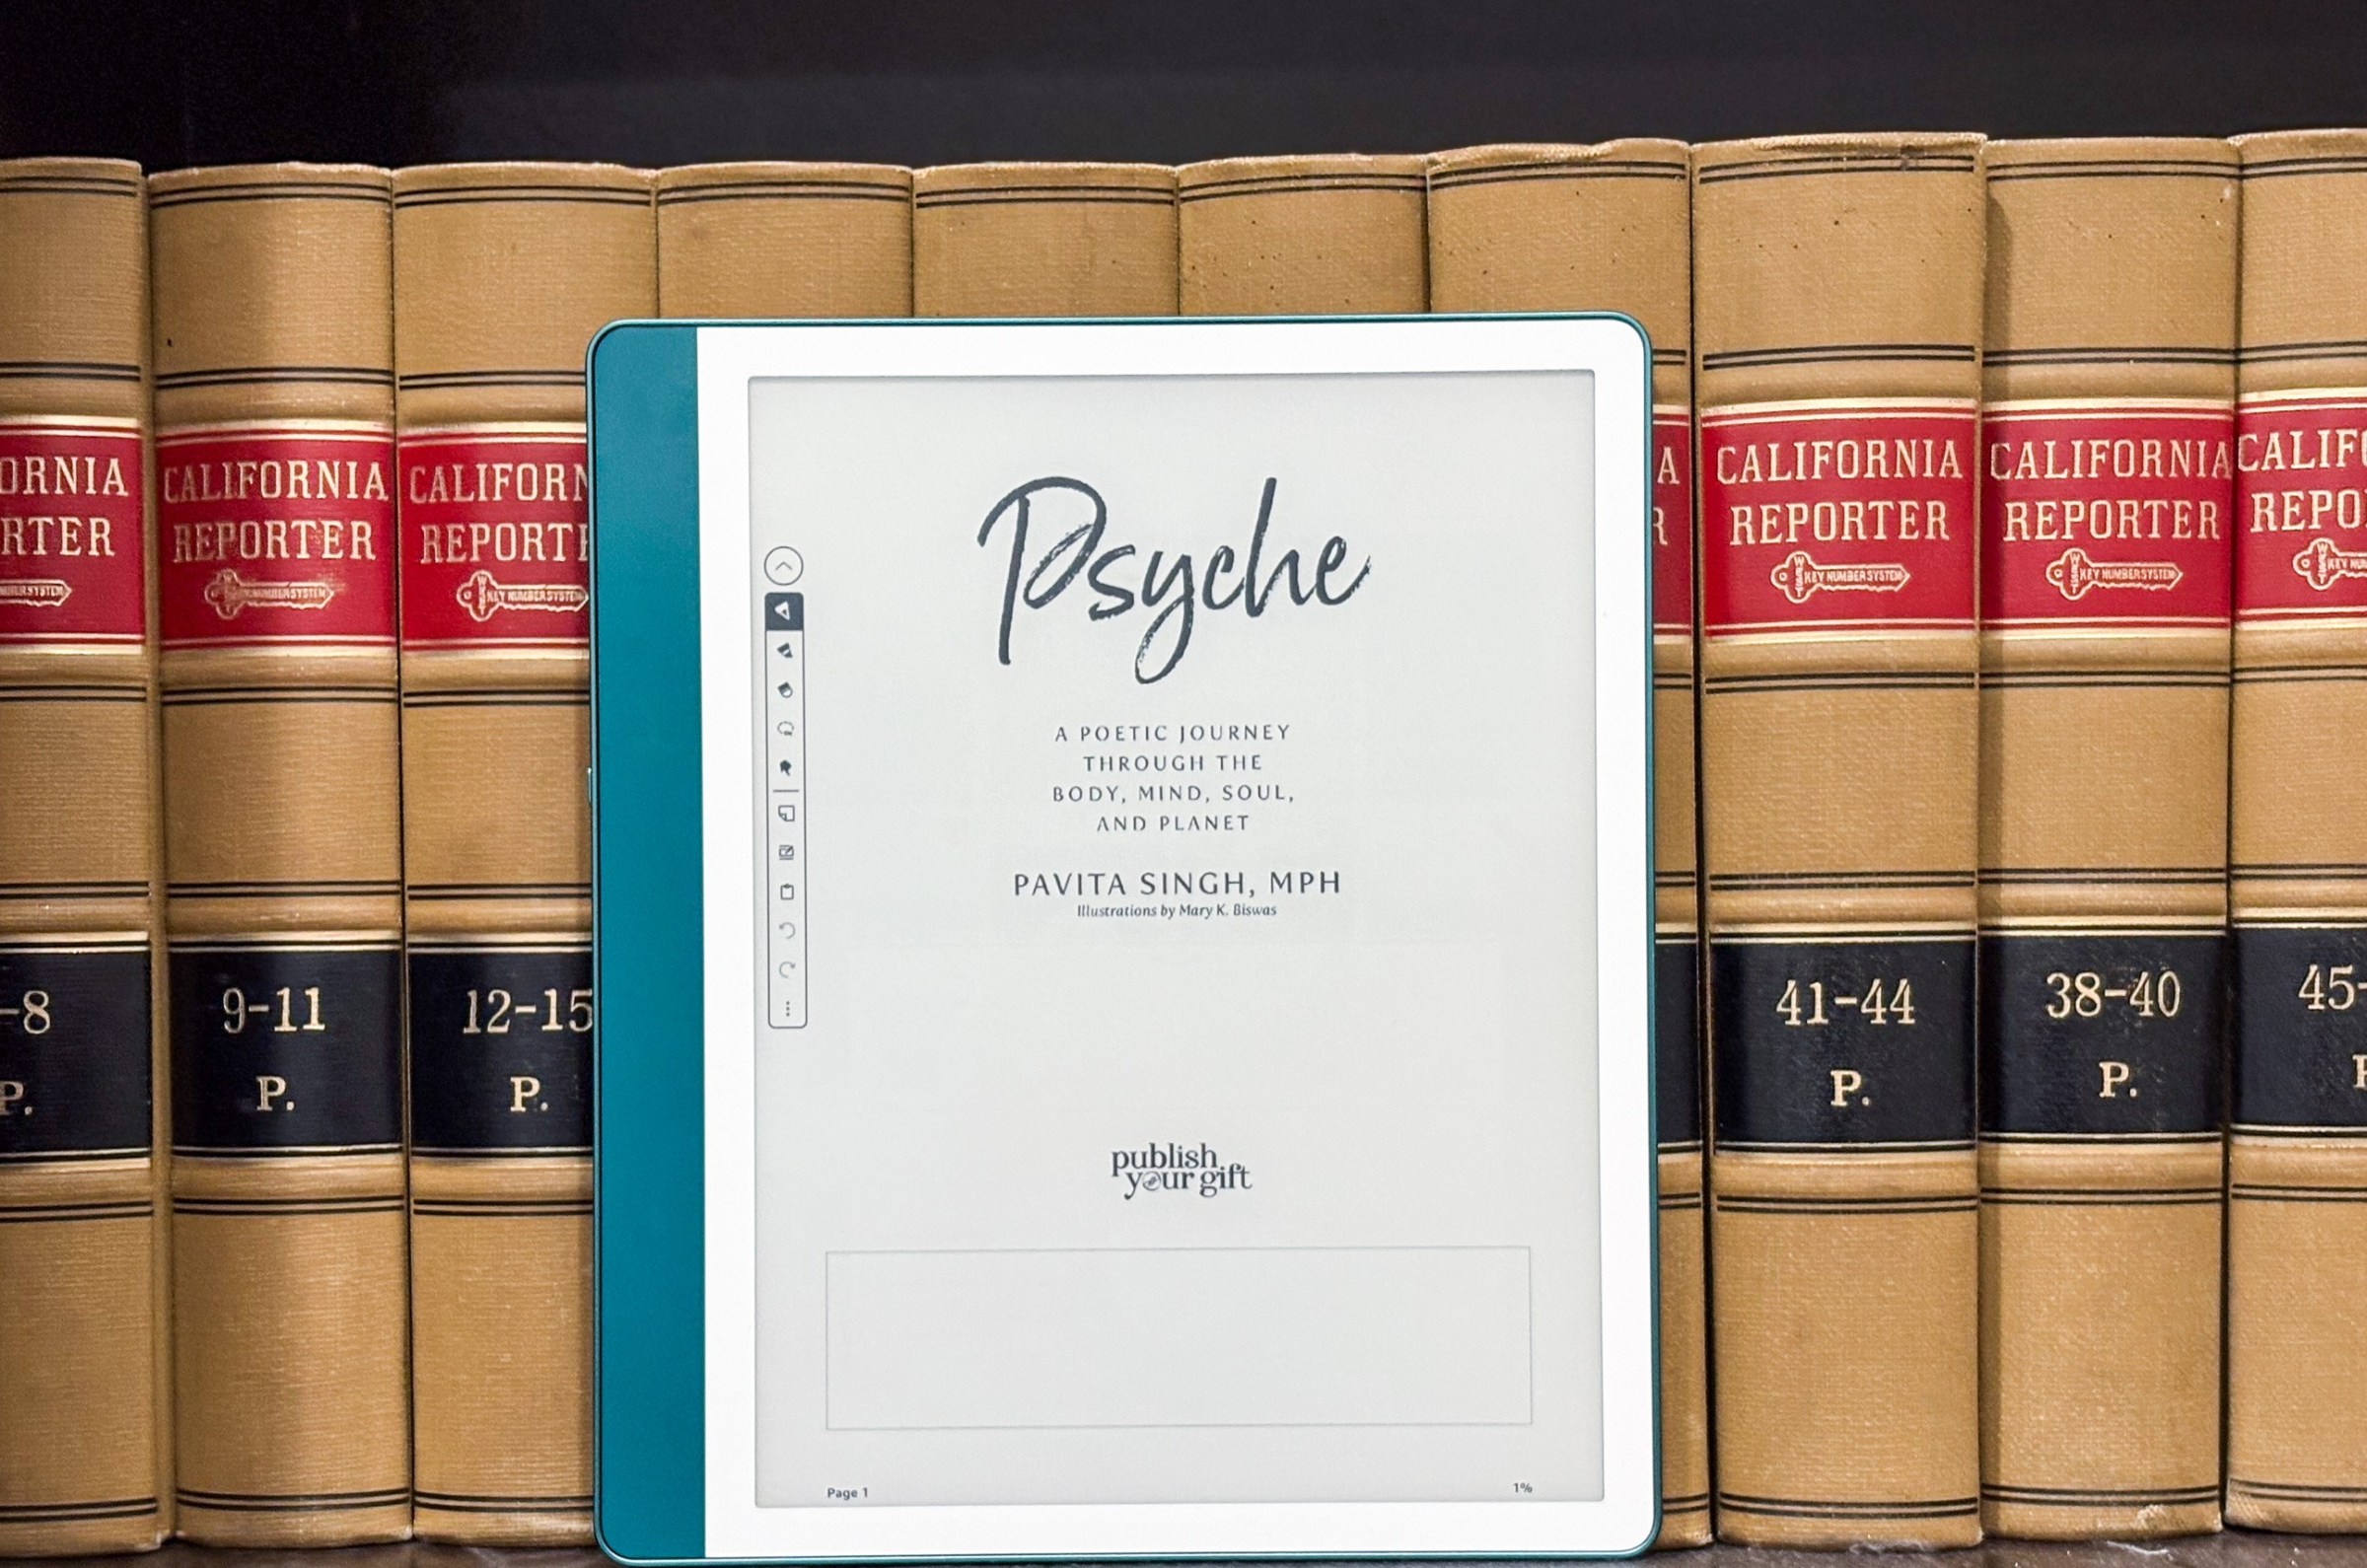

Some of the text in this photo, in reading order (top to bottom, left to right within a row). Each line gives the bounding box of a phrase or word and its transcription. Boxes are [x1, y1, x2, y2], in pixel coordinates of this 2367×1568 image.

[1717, 439, 1963, 484] CALIFORNIA
[1990, 439, 2232, 480] CALIFORNIA
[2238, 428, 2367, 471] CALIF
[163, 460, 389, 503] CALIFORNIA
[1729, 500, 1950, 546] REPORTER
[2002, 499, 2221, 541] REPORTER
[2250, 489, 2367, 533] REPO
[173, 519, 377, 563] REPORTER
[976, 475, 1372, 684] Psyche
[1054, 724, 1290, 745] A POETIC JOURNEY
[1083, 754, 1261, 772] THROUGH THE
[1052, 784, 1294, 804] BODY, MIND, SOUL,
[1097, 815, 1249, 832] AND PLANET
[1014, 871, 1340, 898] PAVITA SINGH, MPH
[1077, 902, 1277, 920] Illustrations by Mary K. Biswas
[223, 987, 325, 1033] 9-11
[463, 988, 593, 1033] 12-15
[1775, 978, 1915, 1026] 41-44
[2046, 971, 2181, 1018] 38-40
[0, 1080, 34, 1115] P.
[256, 1076, 295, 1110] P.
[510, 1076, 548, 1111] P.
[1829, 1070, 1870, 1106] P.
[2098, 1061, 2137, 1098] P.
[1112, 1142, 1218, 1177] publish
[1123, 1163, 1253, 1200] your gift
[826, 1487, 868, 1501] Page 1
[1513, 1482, 1534, 1494] 1%
